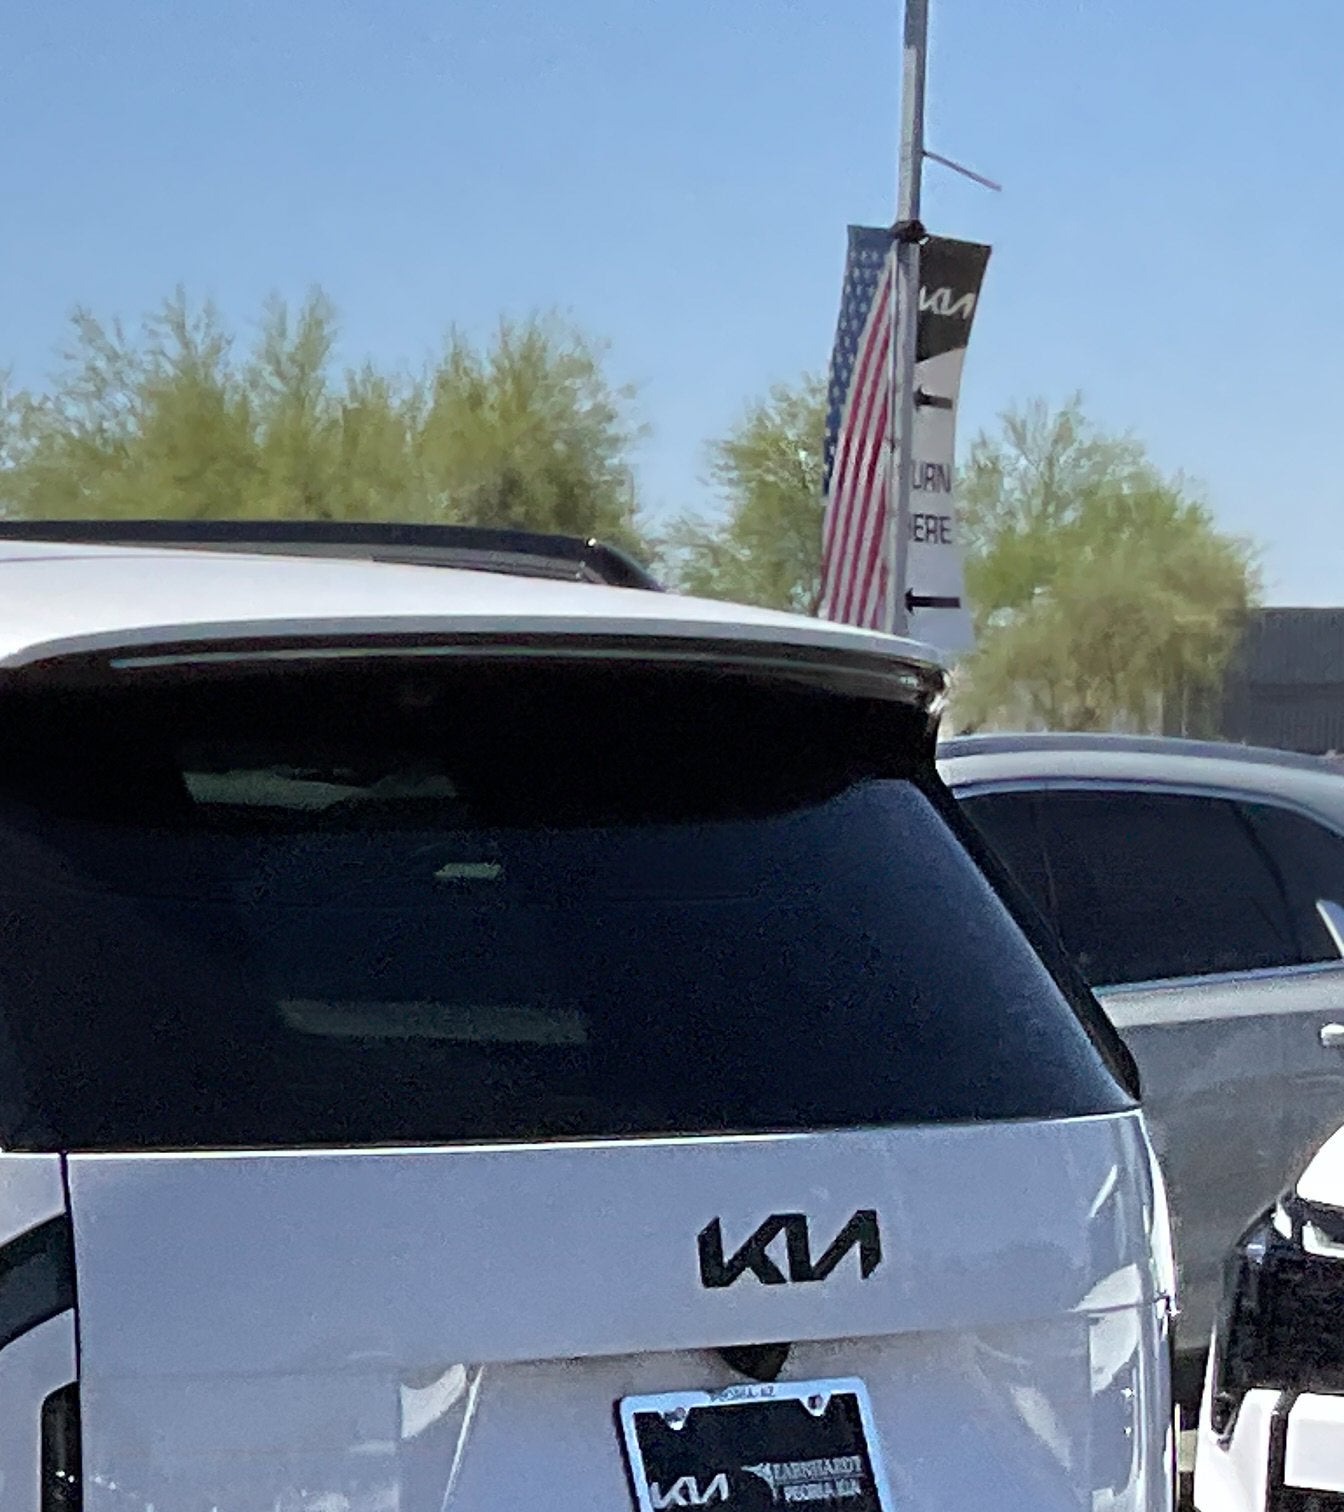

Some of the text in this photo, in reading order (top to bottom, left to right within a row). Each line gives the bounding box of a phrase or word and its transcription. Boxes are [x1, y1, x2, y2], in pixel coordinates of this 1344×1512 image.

[912, 461, 952, 493] URN
[913, 512, 953, 545] ERE
[698, 1209, 882, 1289] KIA
[649, 1473, 729, 1510] KIA
